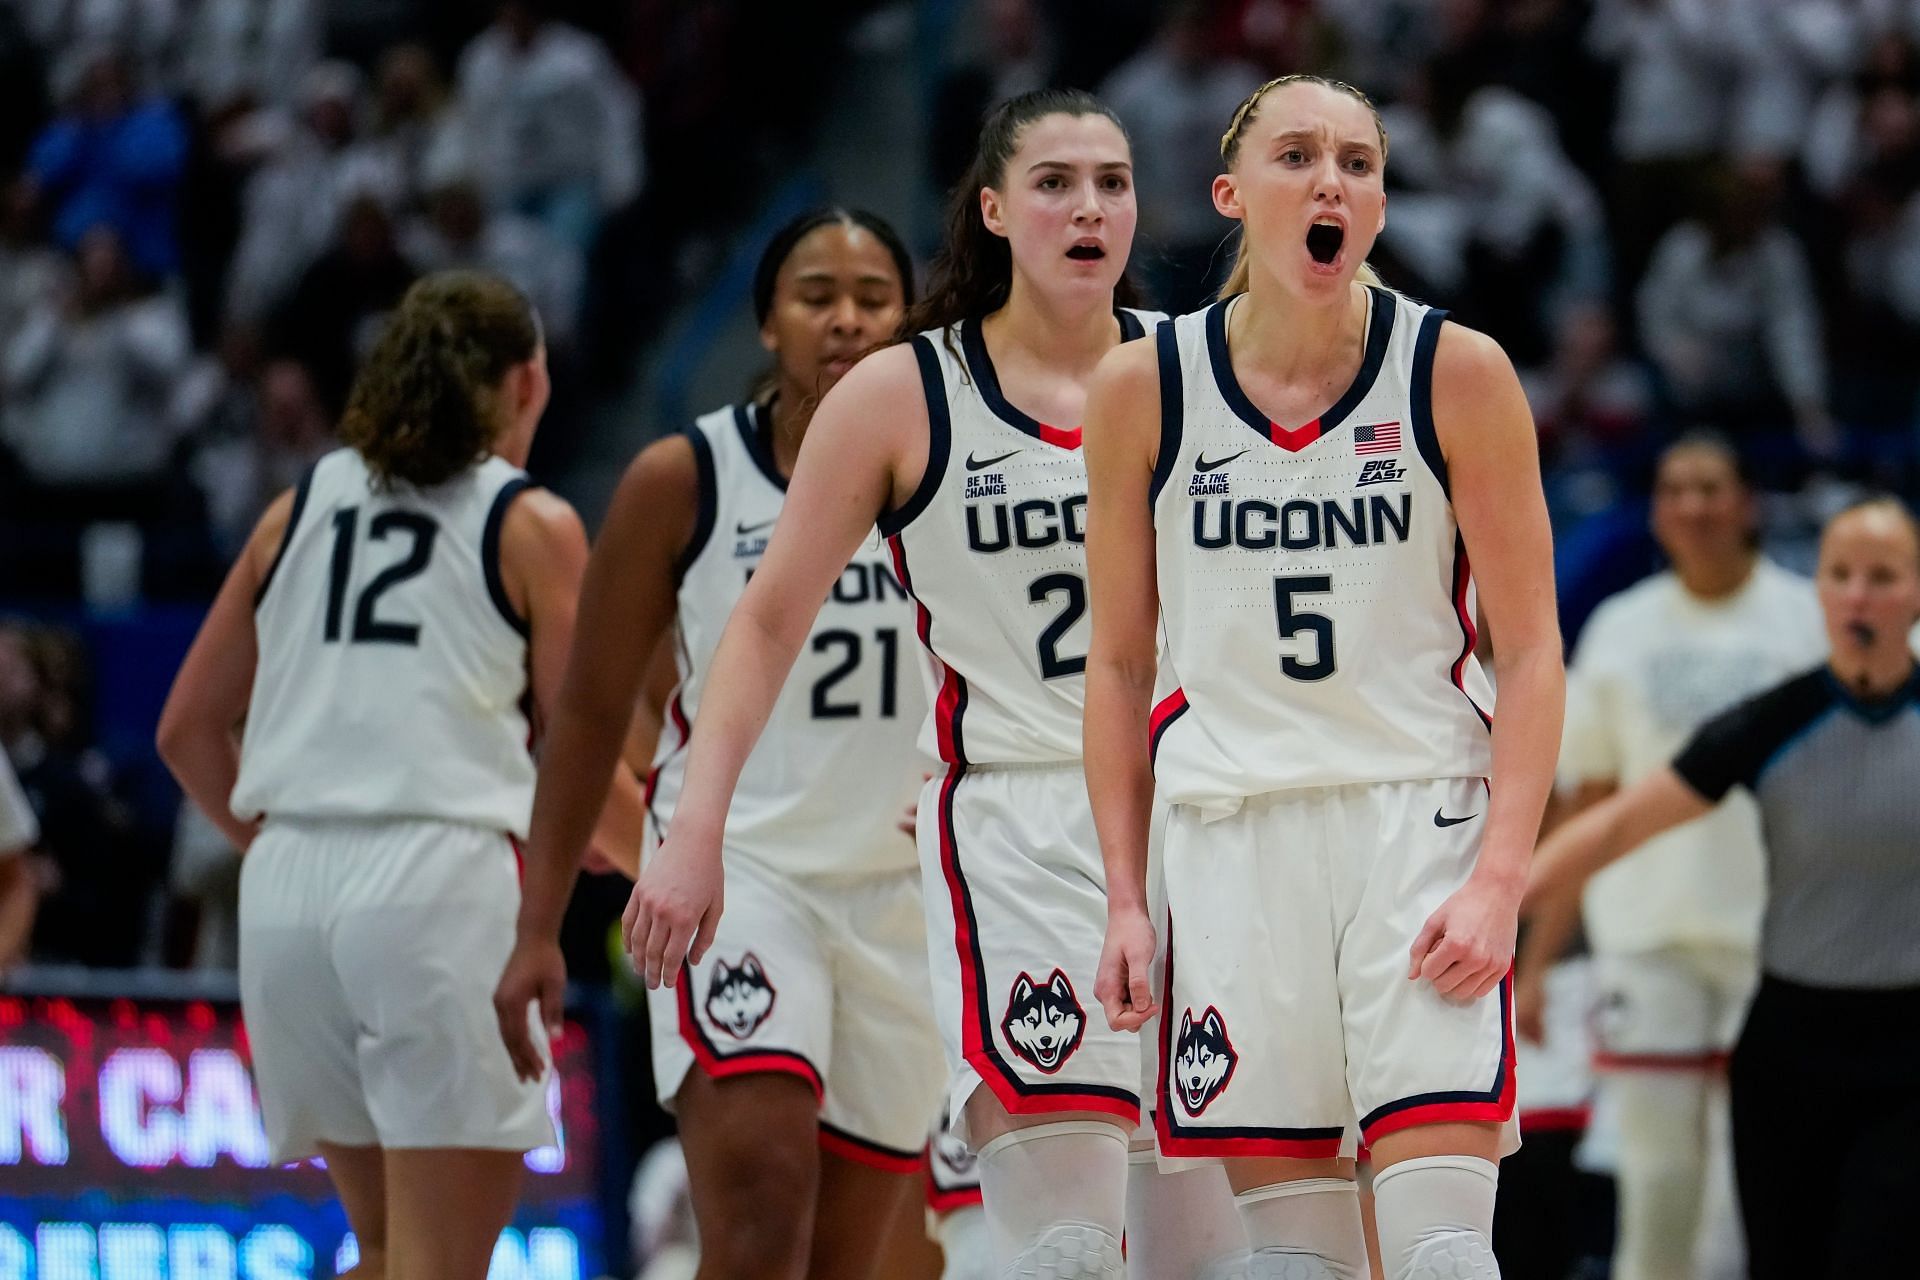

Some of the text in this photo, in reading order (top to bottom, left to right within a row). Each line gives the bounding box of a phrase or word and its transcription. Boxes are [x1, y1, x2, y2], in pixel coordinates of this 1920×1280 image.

[1362, 458, 1398, 472] BIG
[967, 473, 1004, 487] BE THE
[1191, 472, 1230, 485] BE THE
[1358, 468, 1408, 483] EAST
[965, 484, 1007, 499] CHANGE
[1188, 482, 1230, 497] CHANGE
[965, 494, 1088, 554] UCO
[1192, 492, 1412, 552] UCONN
[323, 505, 439, 646] 12
[1273, 573, 1338, 683] 5
[810, 627, 899, 720] 21
